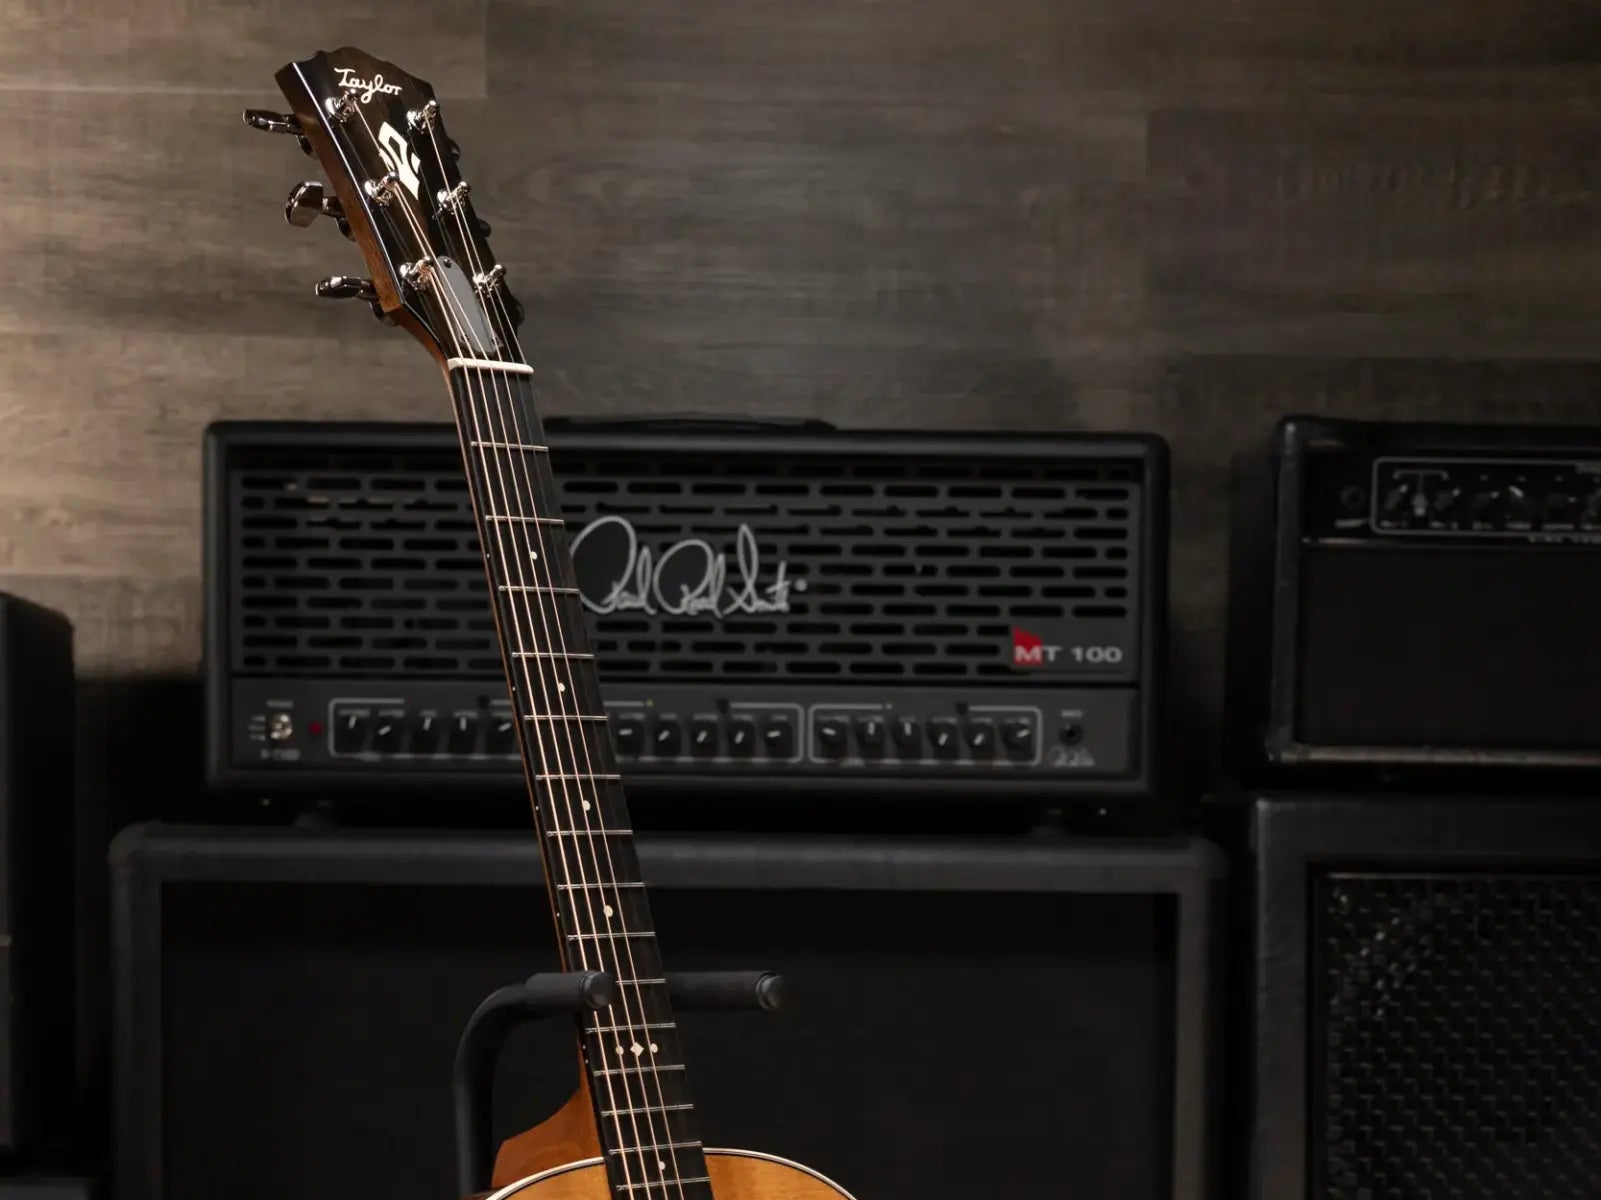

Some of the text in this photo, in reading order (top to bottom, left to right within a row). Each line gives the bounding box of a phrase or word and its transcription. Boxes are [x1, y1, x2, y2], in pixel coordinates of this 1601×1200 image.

[333, 66, 403, 105] Taylor
[1015, 645, 1123, 663] MT 100
